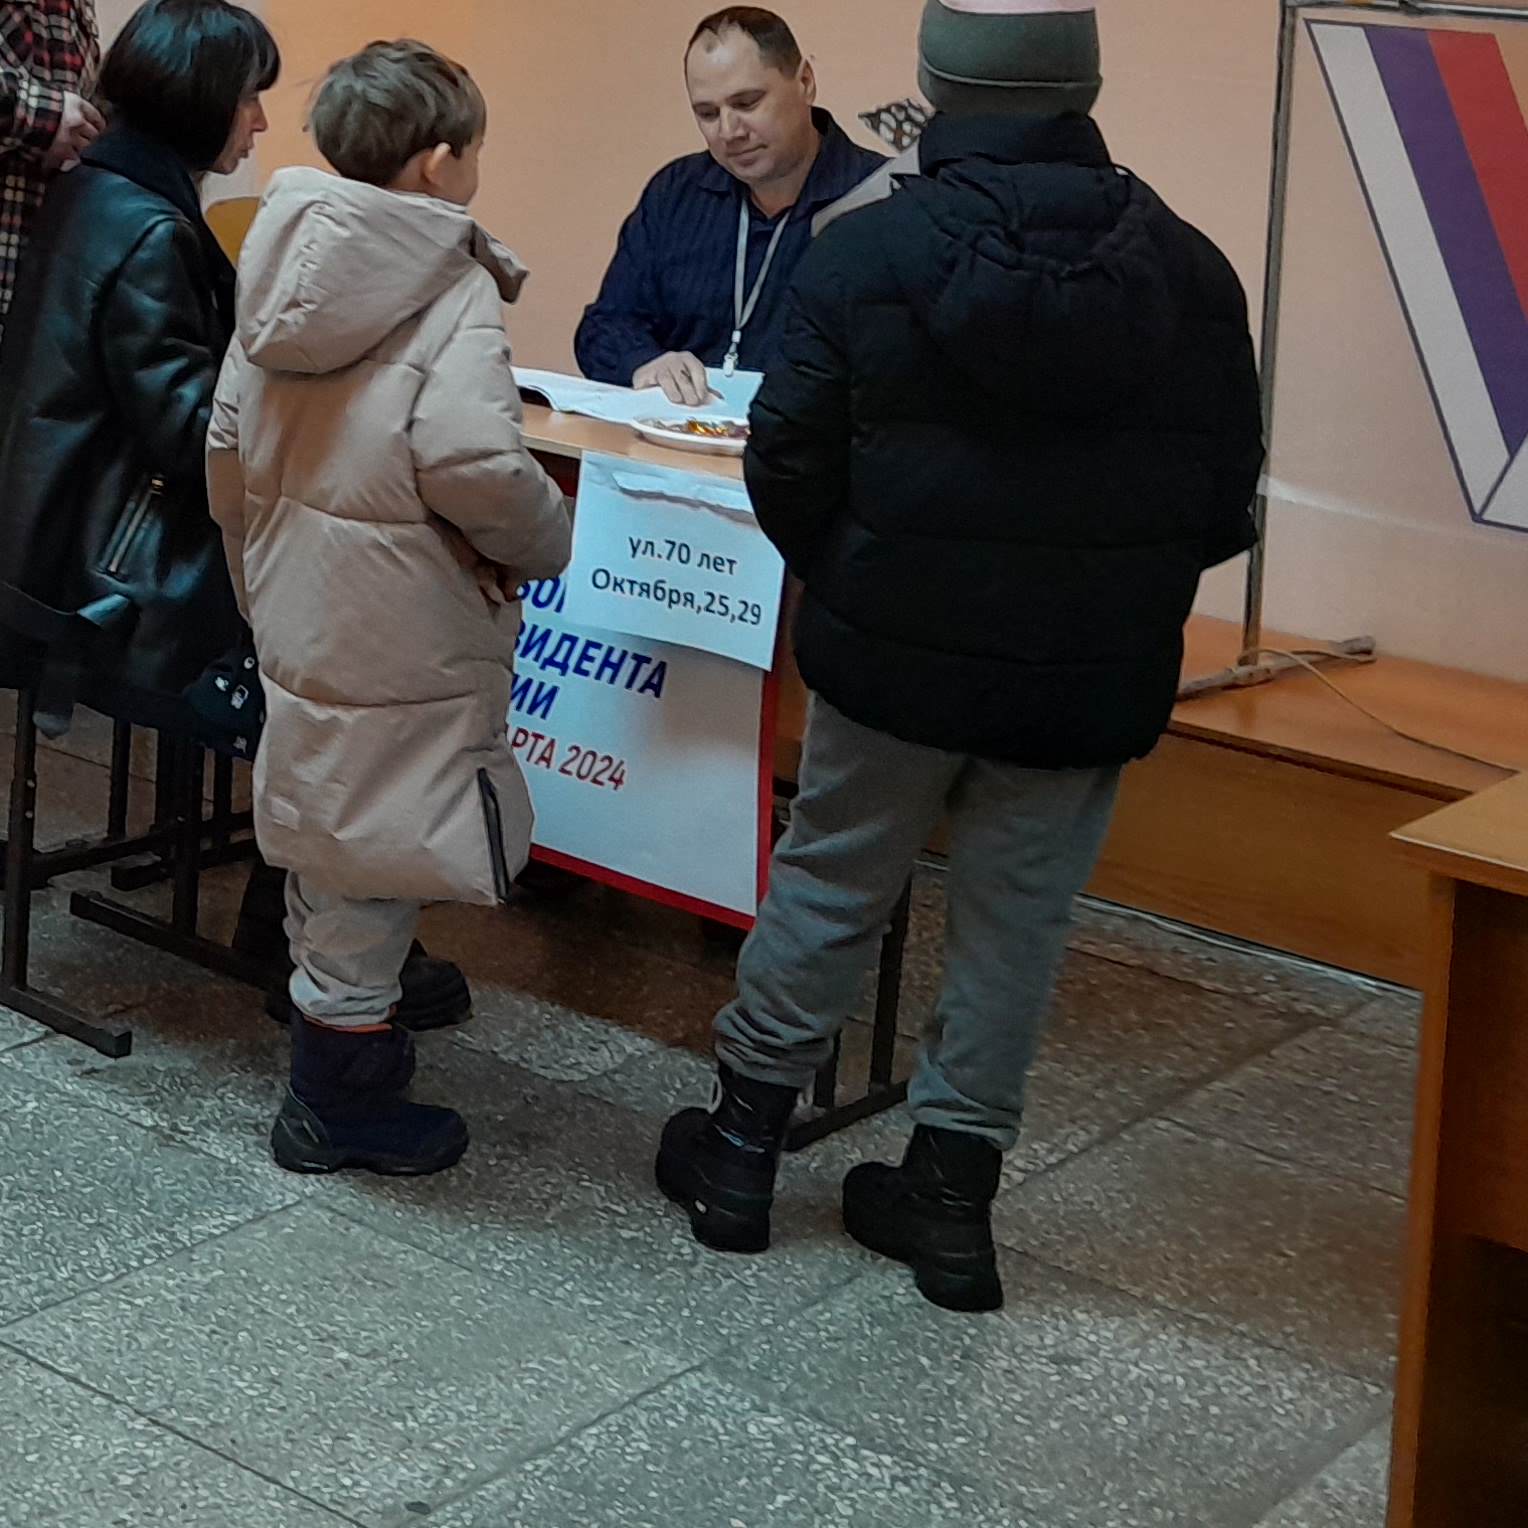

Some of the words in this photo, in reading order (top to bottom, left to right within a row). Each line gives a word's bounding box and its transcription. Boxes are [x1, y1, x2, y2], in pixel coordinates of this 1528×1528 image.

[628, 536, 691, 565] ул.70
[696, 552, 737, 575] лет
[591, 568, 762, 626] Октября,25,29
[558, 744, 626, 791] 2024
